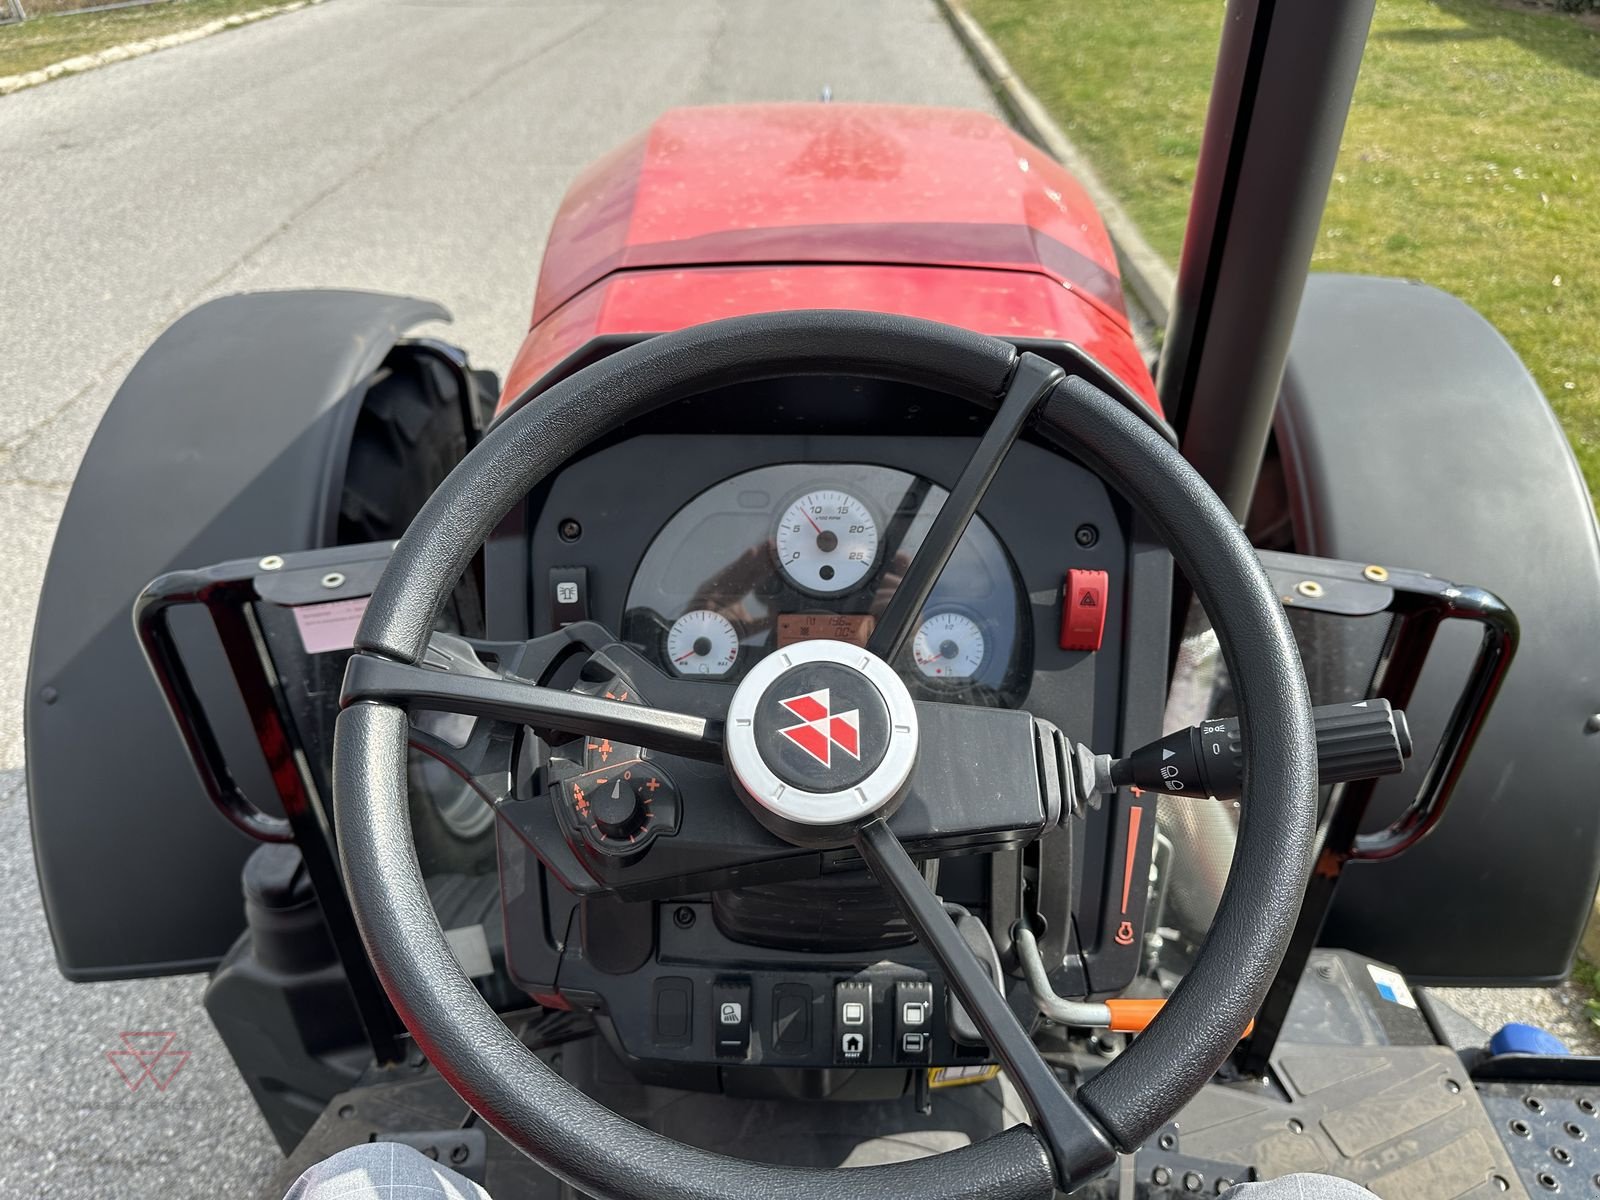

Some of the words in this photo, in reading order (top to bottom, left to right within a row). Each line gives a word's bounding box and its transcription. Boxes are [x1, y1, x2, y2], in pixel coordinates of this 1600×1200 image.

[810, 506, 822, 514] 10
[837, 506, 849, 514] 15
[793, 525, 800, 533] 5
[849, 525, 864, 533] 20
[793, 551, 801, 559] 0
[848, 552, 864, 560] 25
[1212, 743, 1220, 755] 0
[624, 770, 632, 780] 0
